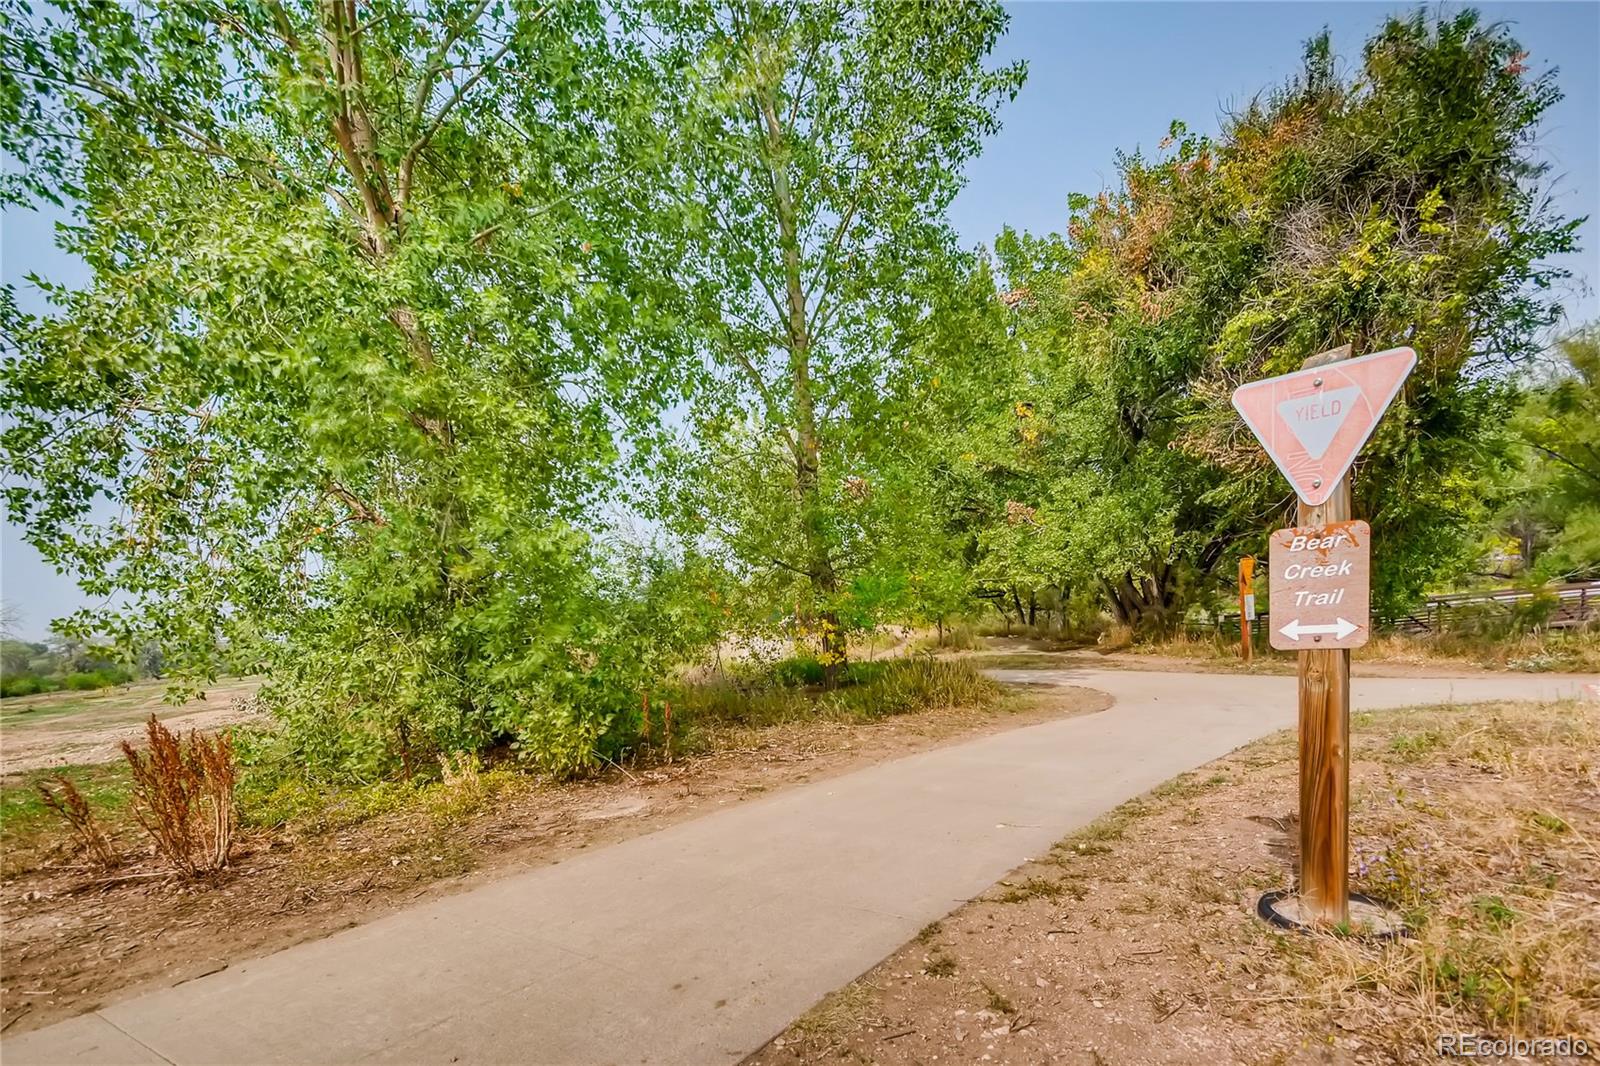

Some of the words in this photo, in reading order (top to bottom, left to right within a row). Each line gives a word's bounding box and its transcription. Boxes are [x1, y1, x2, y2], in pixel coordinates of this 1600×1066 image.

[1295, 399, 1342, 422] YIELD
[1290, 534, 1347, 552] Bear
[1284, 560, 1353, 580] Creek
[1295, 588, 1345, 607] Trail
